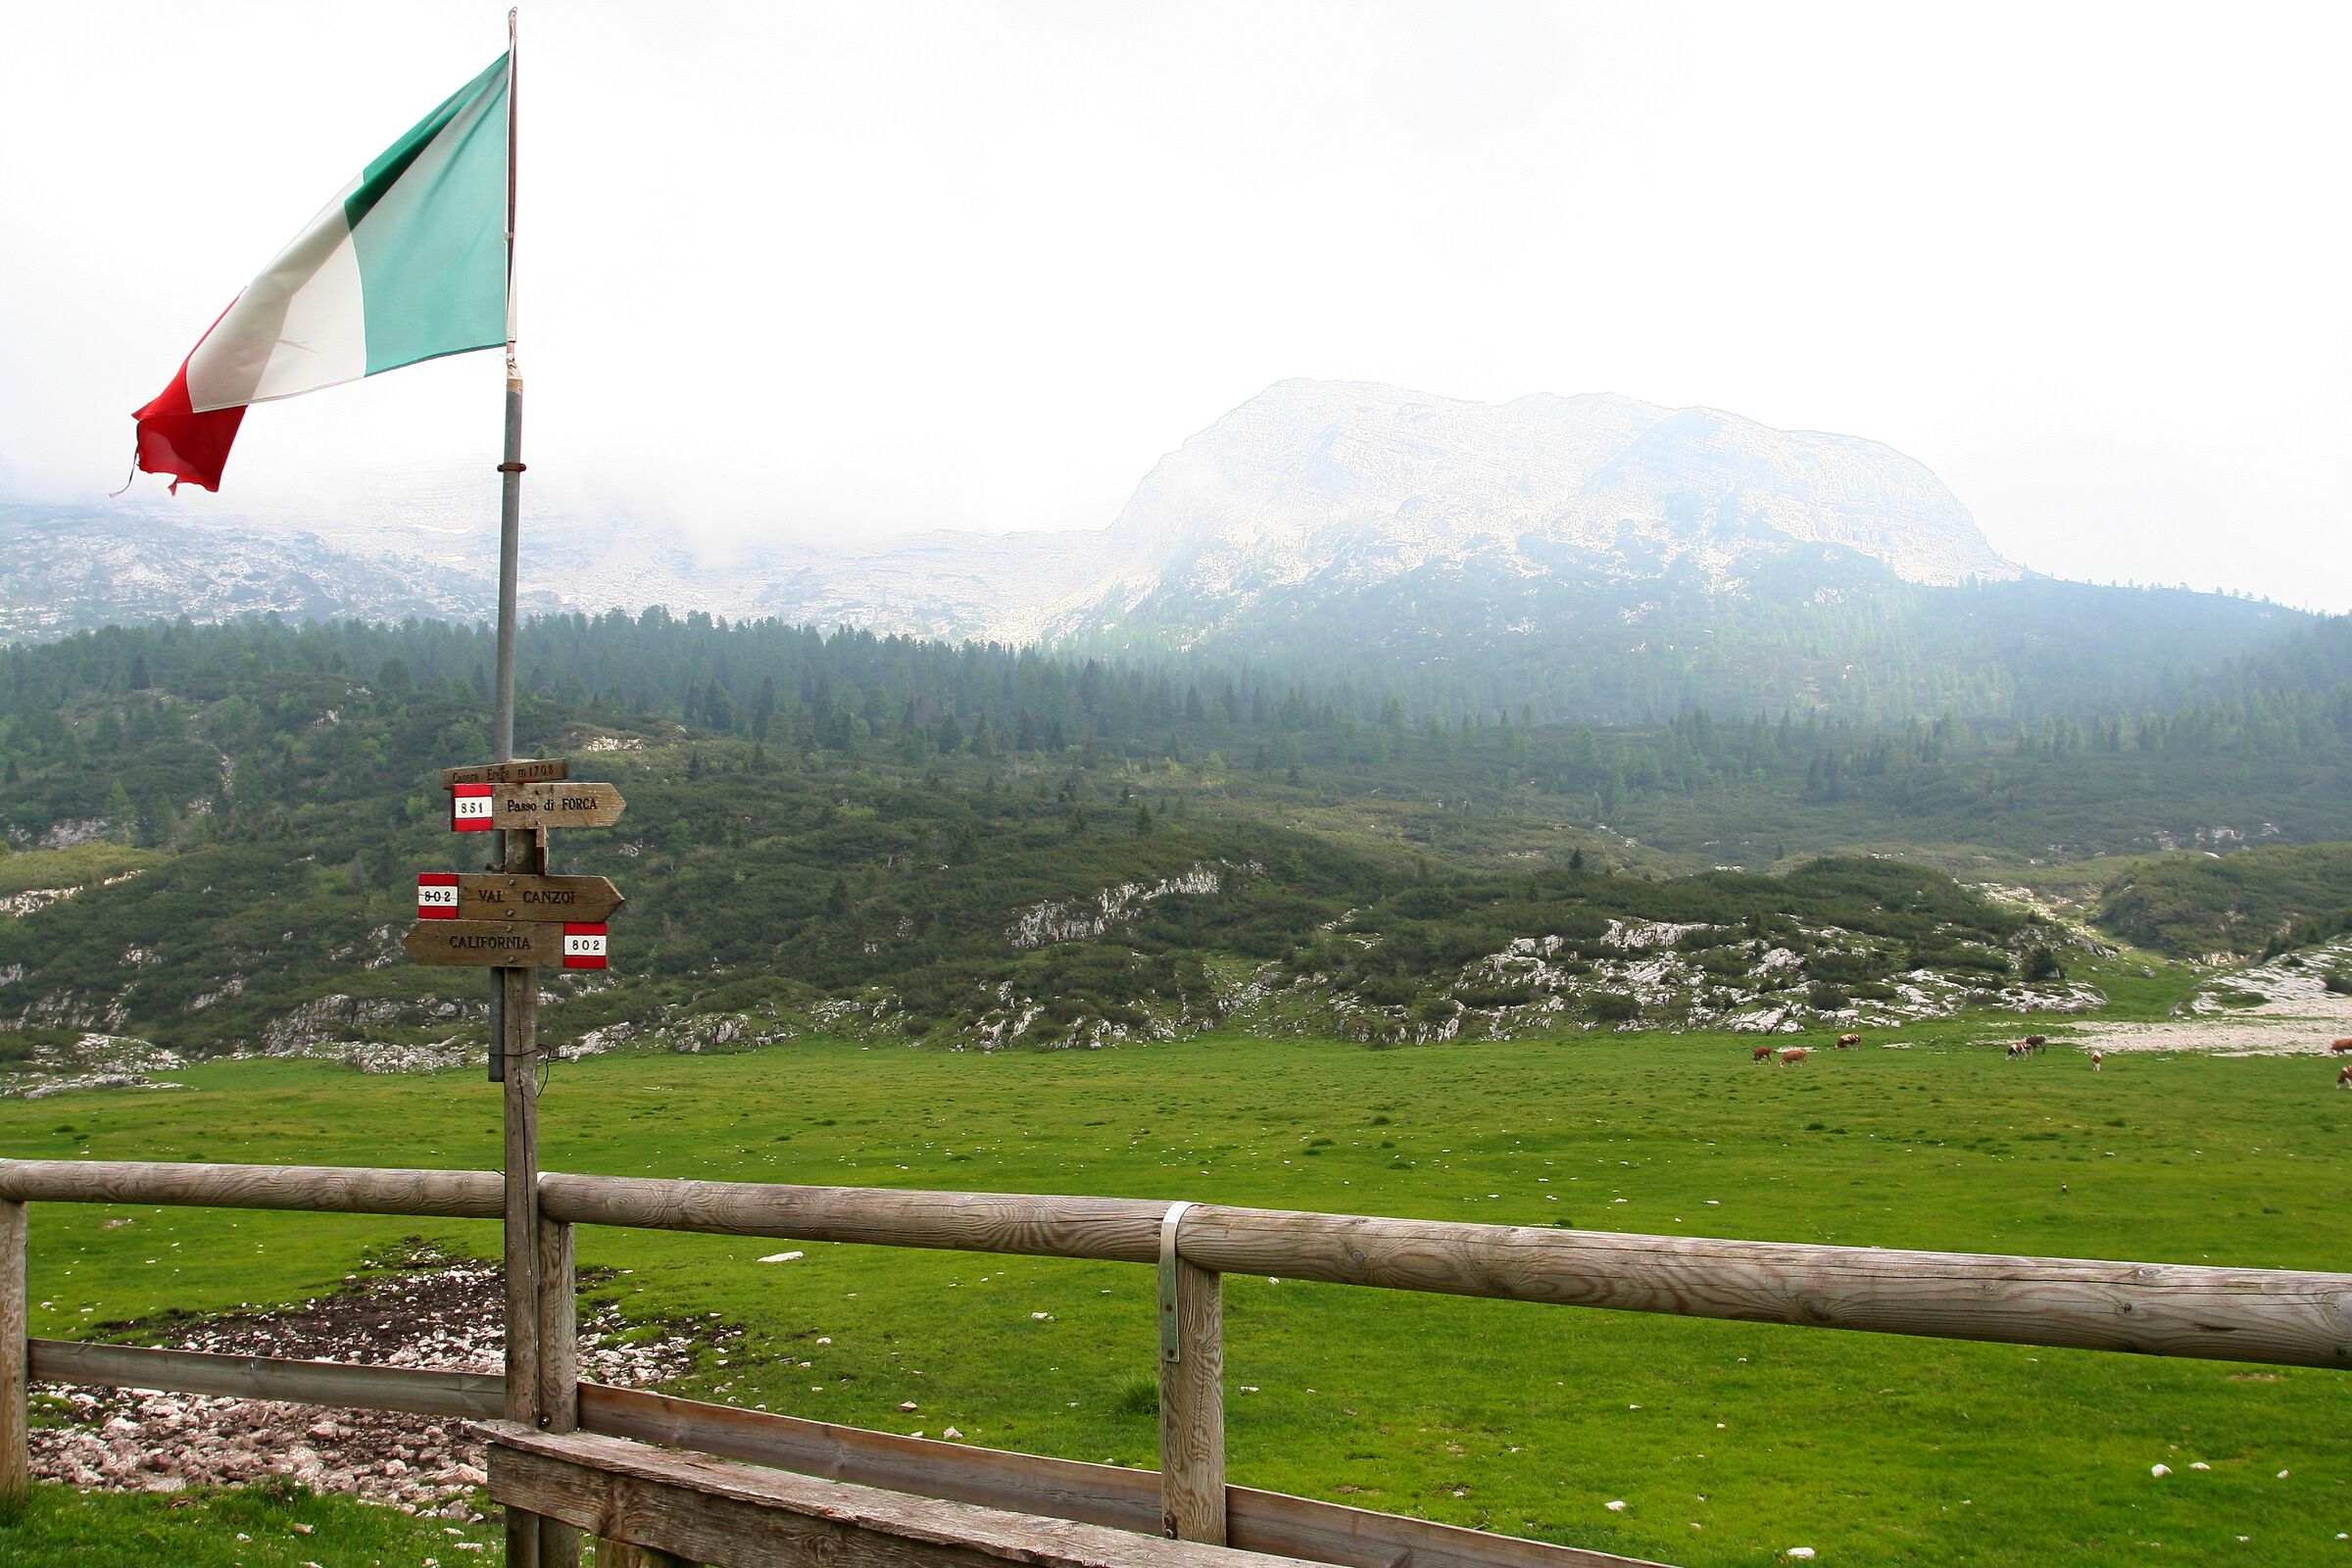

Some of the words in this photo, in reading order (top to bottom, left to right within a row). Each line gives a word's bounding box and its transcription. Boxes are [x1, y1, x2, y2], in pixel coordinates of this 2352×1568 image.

[461, 802, 483, 813] 851
[507, 799, 537, 812] Passo
[544, 799, 555, 811] di
[562, 798, 598, 810] FORCA
[424, 891, 451, 903] 802
[478, 890, 505, 903] VAL
[522, 890, 576, 904] CANZOI
[449, 936, 531, 950] CALIFORNIA
[572, 939, 600, 951] 802
